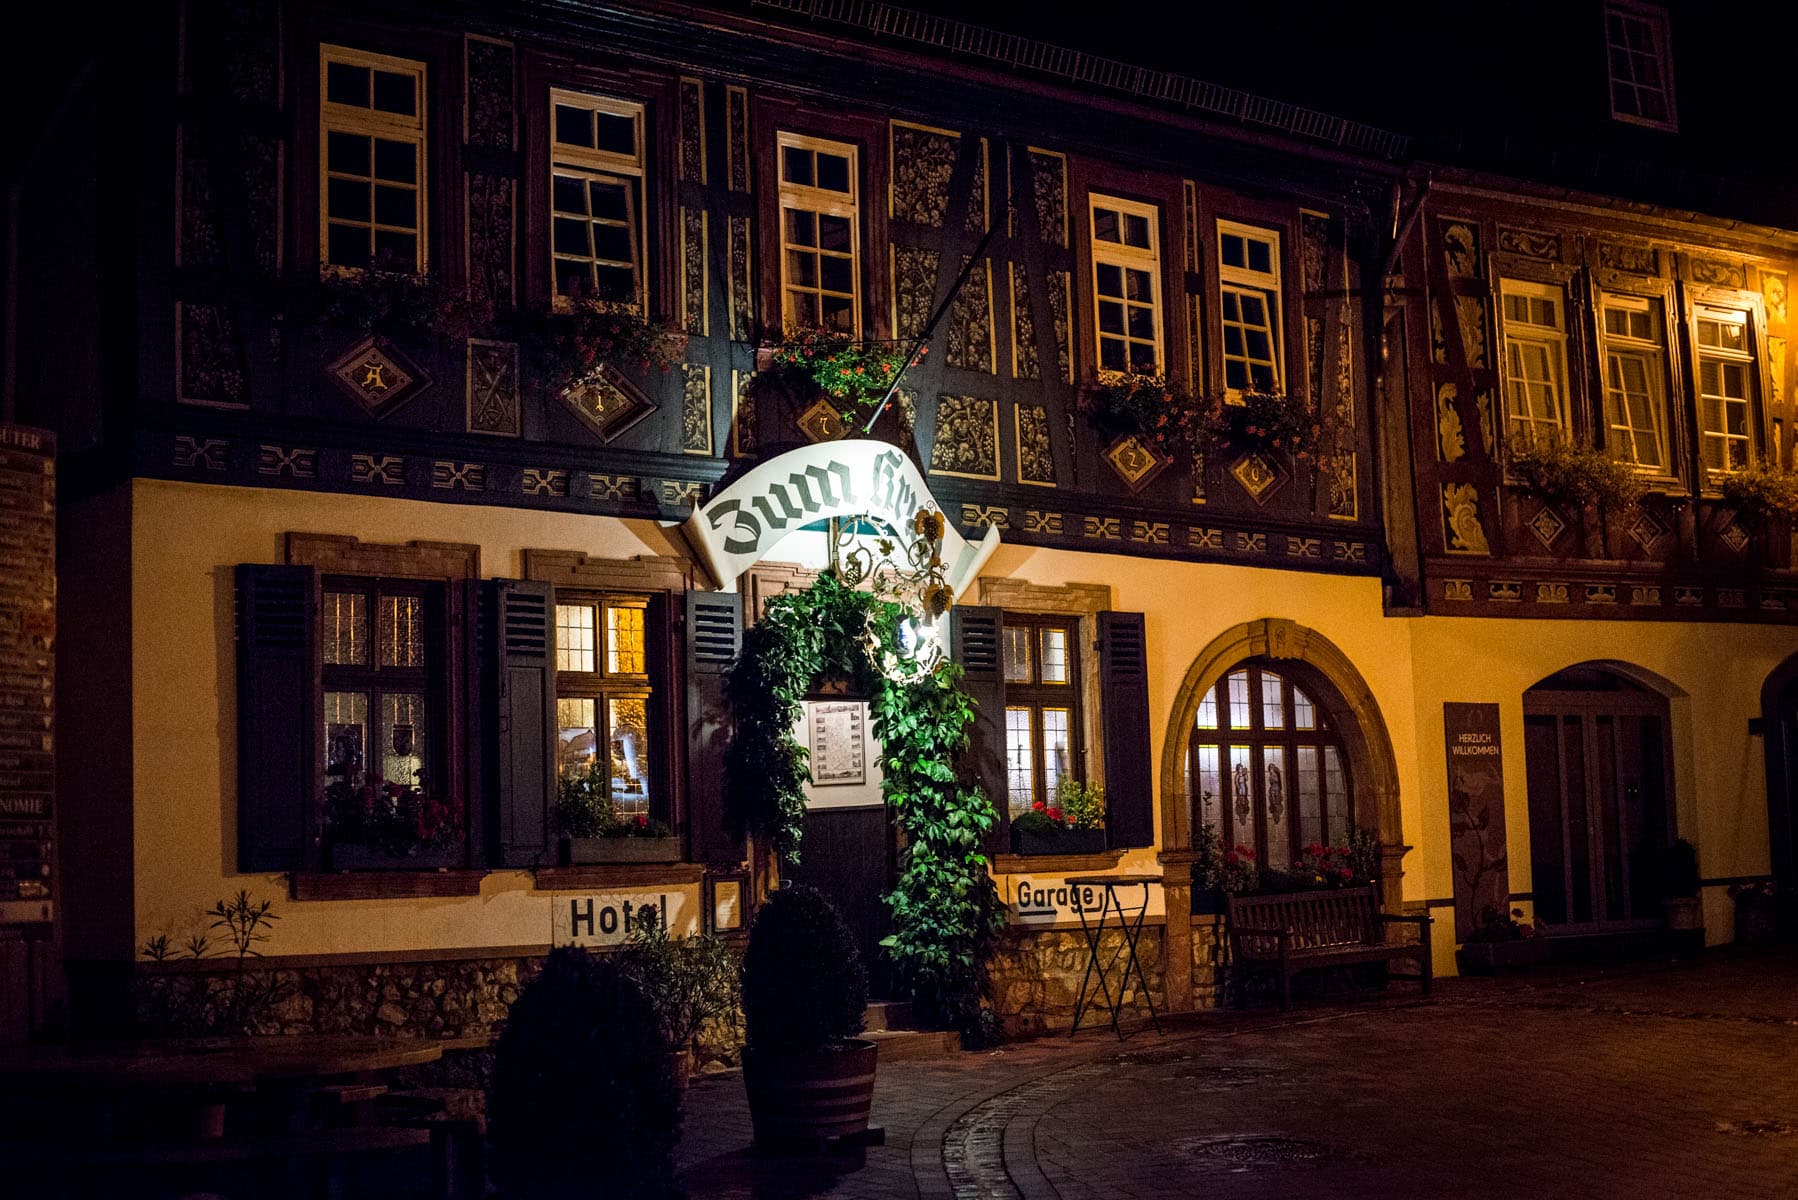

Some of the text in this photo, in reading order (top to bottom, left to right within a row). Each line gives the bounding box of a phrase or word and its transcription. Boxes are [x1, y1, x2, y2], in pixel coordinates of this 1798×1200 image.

[819, 417, 830, 435] 7
[1128, 453, 1138, 468] 2
[706, 460, 858, 555] Zum
[1458, 733, 1492, 743] HERZLICH
[1452, 745, 1500, 756] WILLKOMMEN
[1018, 881, 1094, 912] Garage
